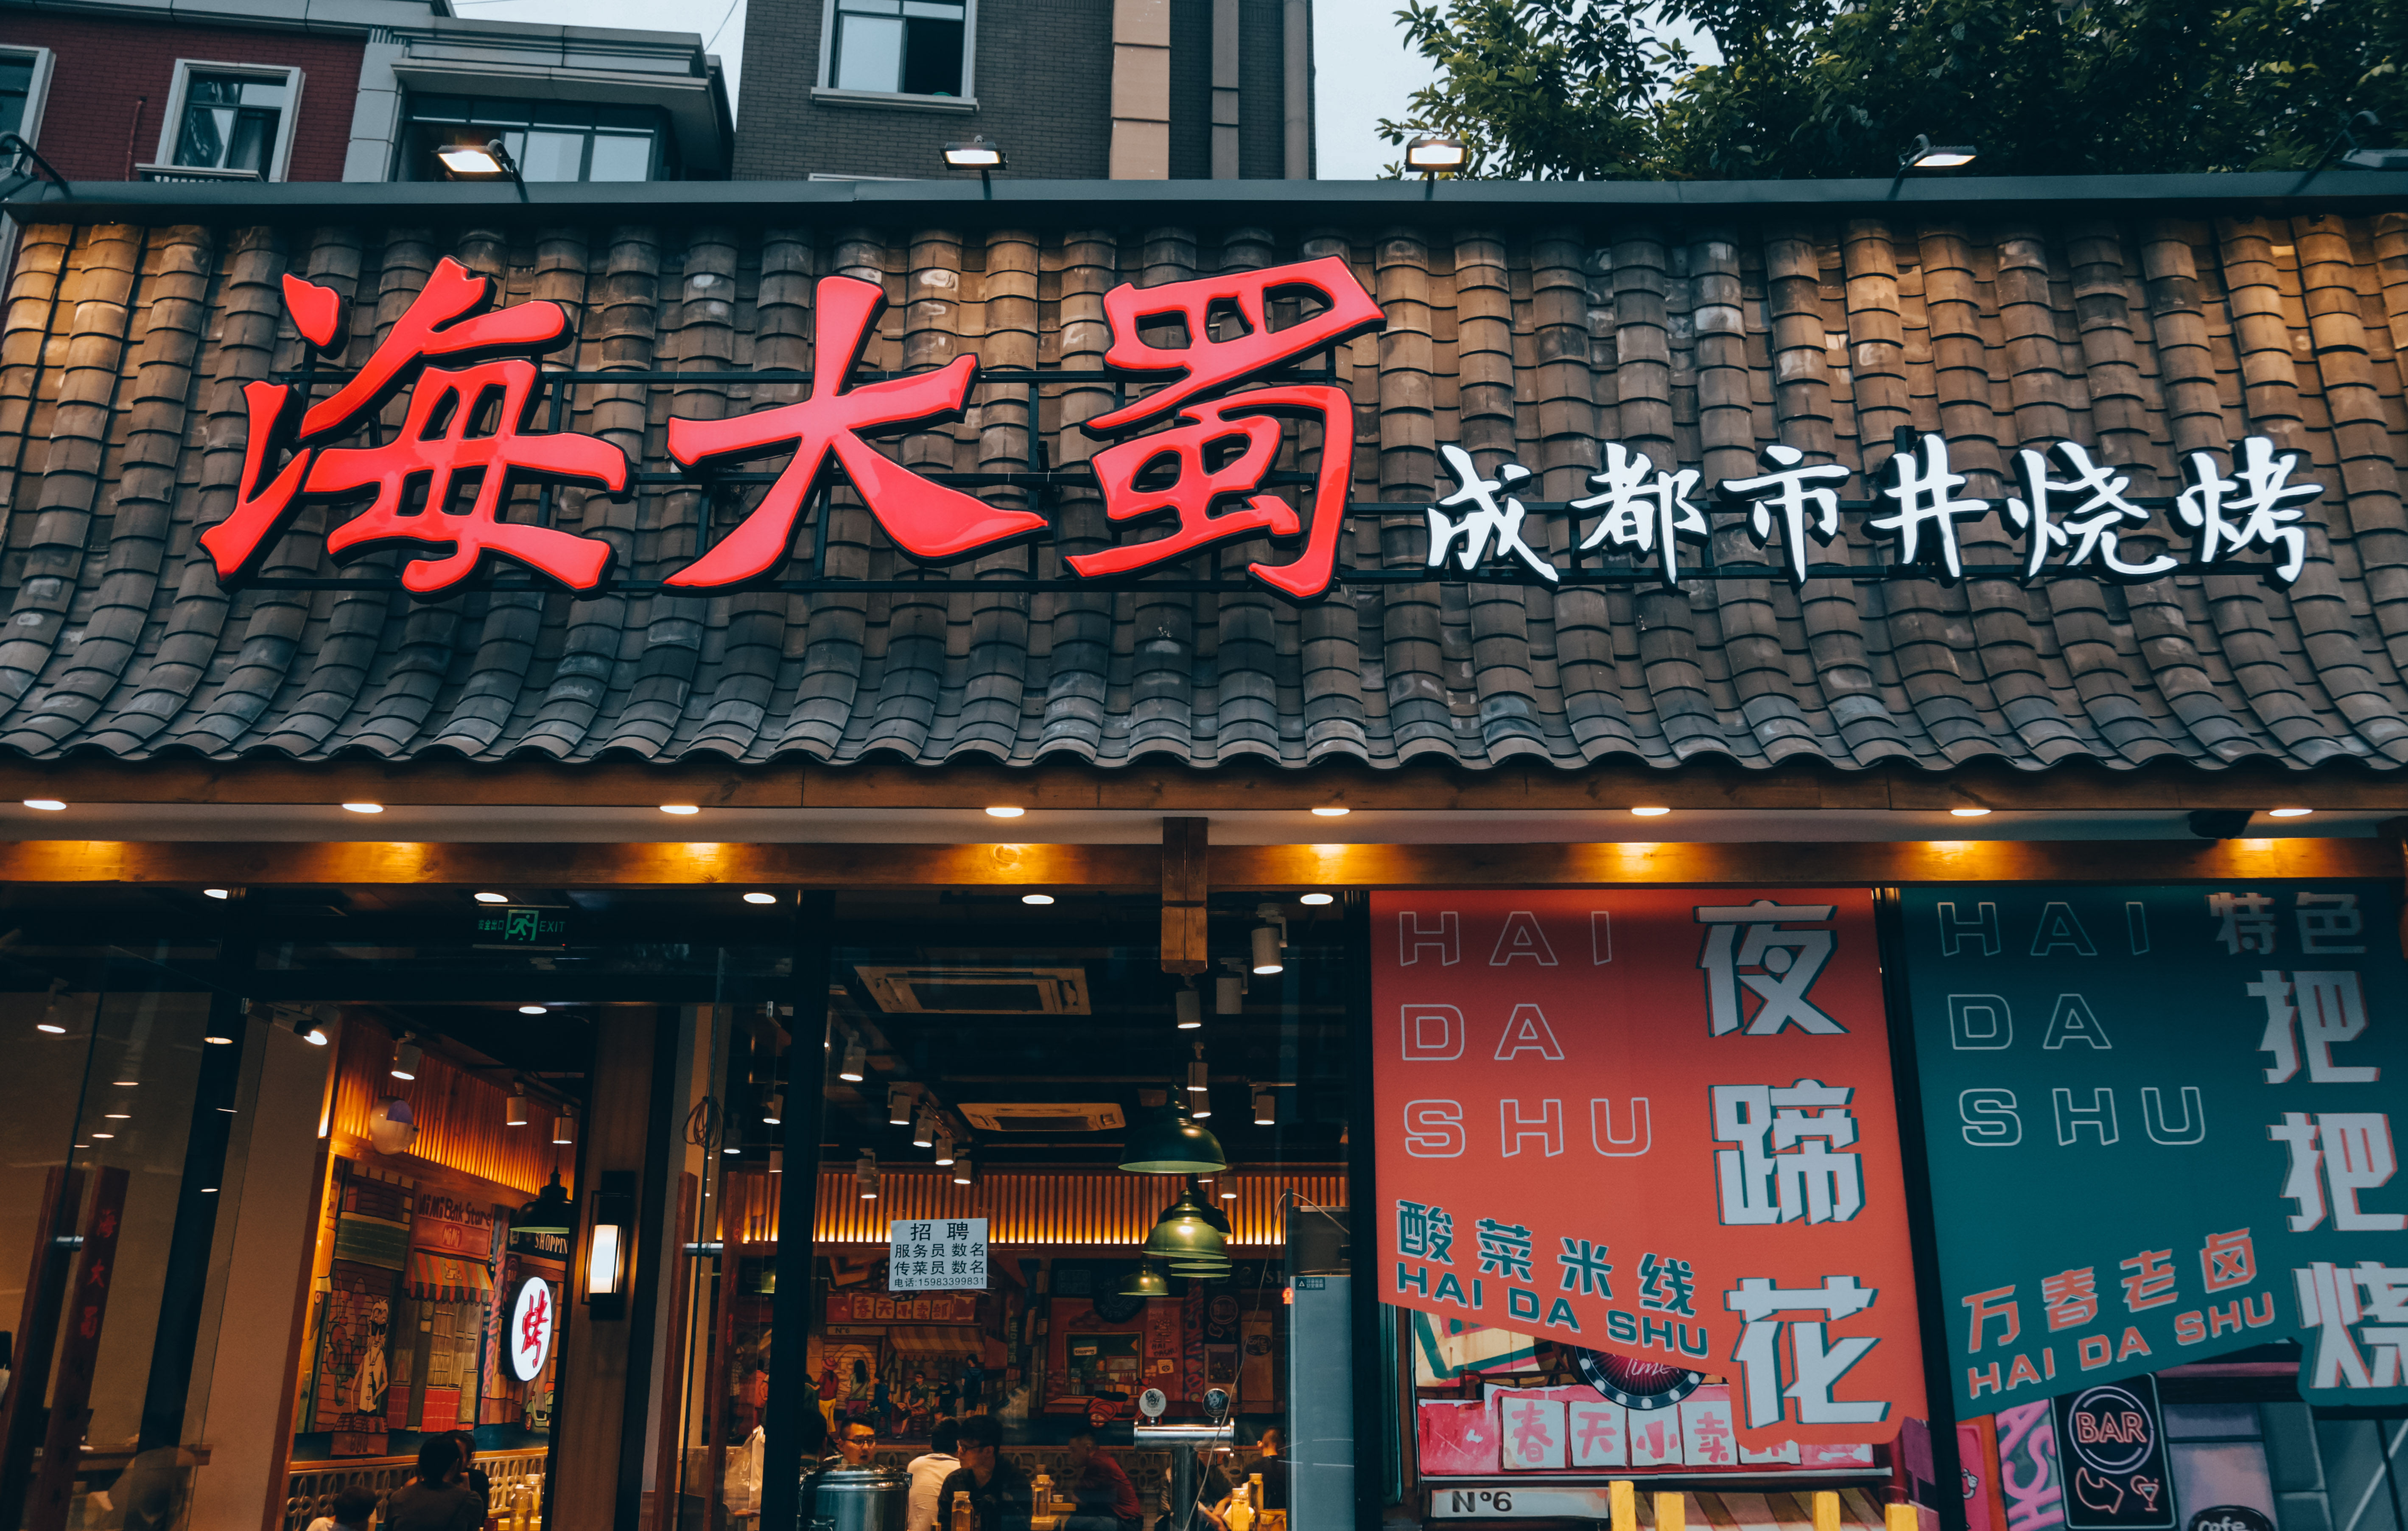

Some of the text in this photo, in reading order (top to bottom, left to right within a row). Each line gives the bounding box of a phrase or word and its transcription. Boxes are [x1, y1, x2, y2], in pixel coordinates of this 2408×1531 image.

[199, 256, 1386, 600] 海大蜀
[1424, 434, 2323, 592] 成都市井烧烤
[478, 919, 505, 931] 安全出口
[539, 921, 566, 932] EXIT
[1399, 911, 1612, 966] HAI
[1937, 901, 2150, 956] HAI
[2207, 891, 2367, 955] 特色
[1401, 1004, 1565, 1061] DA
[1948, 993, 2112, 1050] DA
[1404, 1097, 1651, 1158] SHU
[1959, 1086, 2206, 1146] SHU
[1693, 899, 1891, 1430] 夜蹄花
[2244, 969, 2408, 1389] 把把烧
[895, 1243, 984, 1258] 服务员 数名
[910, 1222, 969, 1241] 招聘
[1396, 1199, 1696, 1318] 酸菜米线
[894, 1260, 984, 1276] 传菜员 数名
[1962, 1227, 2257, 1354] 万春老卤
[521, 1289, 548, 1368] 烤
[1396, 1262, 1709, 1359] HAI DA SHU
[1967, 1291, 2276, 1399] HAI DA SHU
[1511, 1401, 1787, 1462] 春天小卖
[2075, 1411, 2148, 1444] BAR
